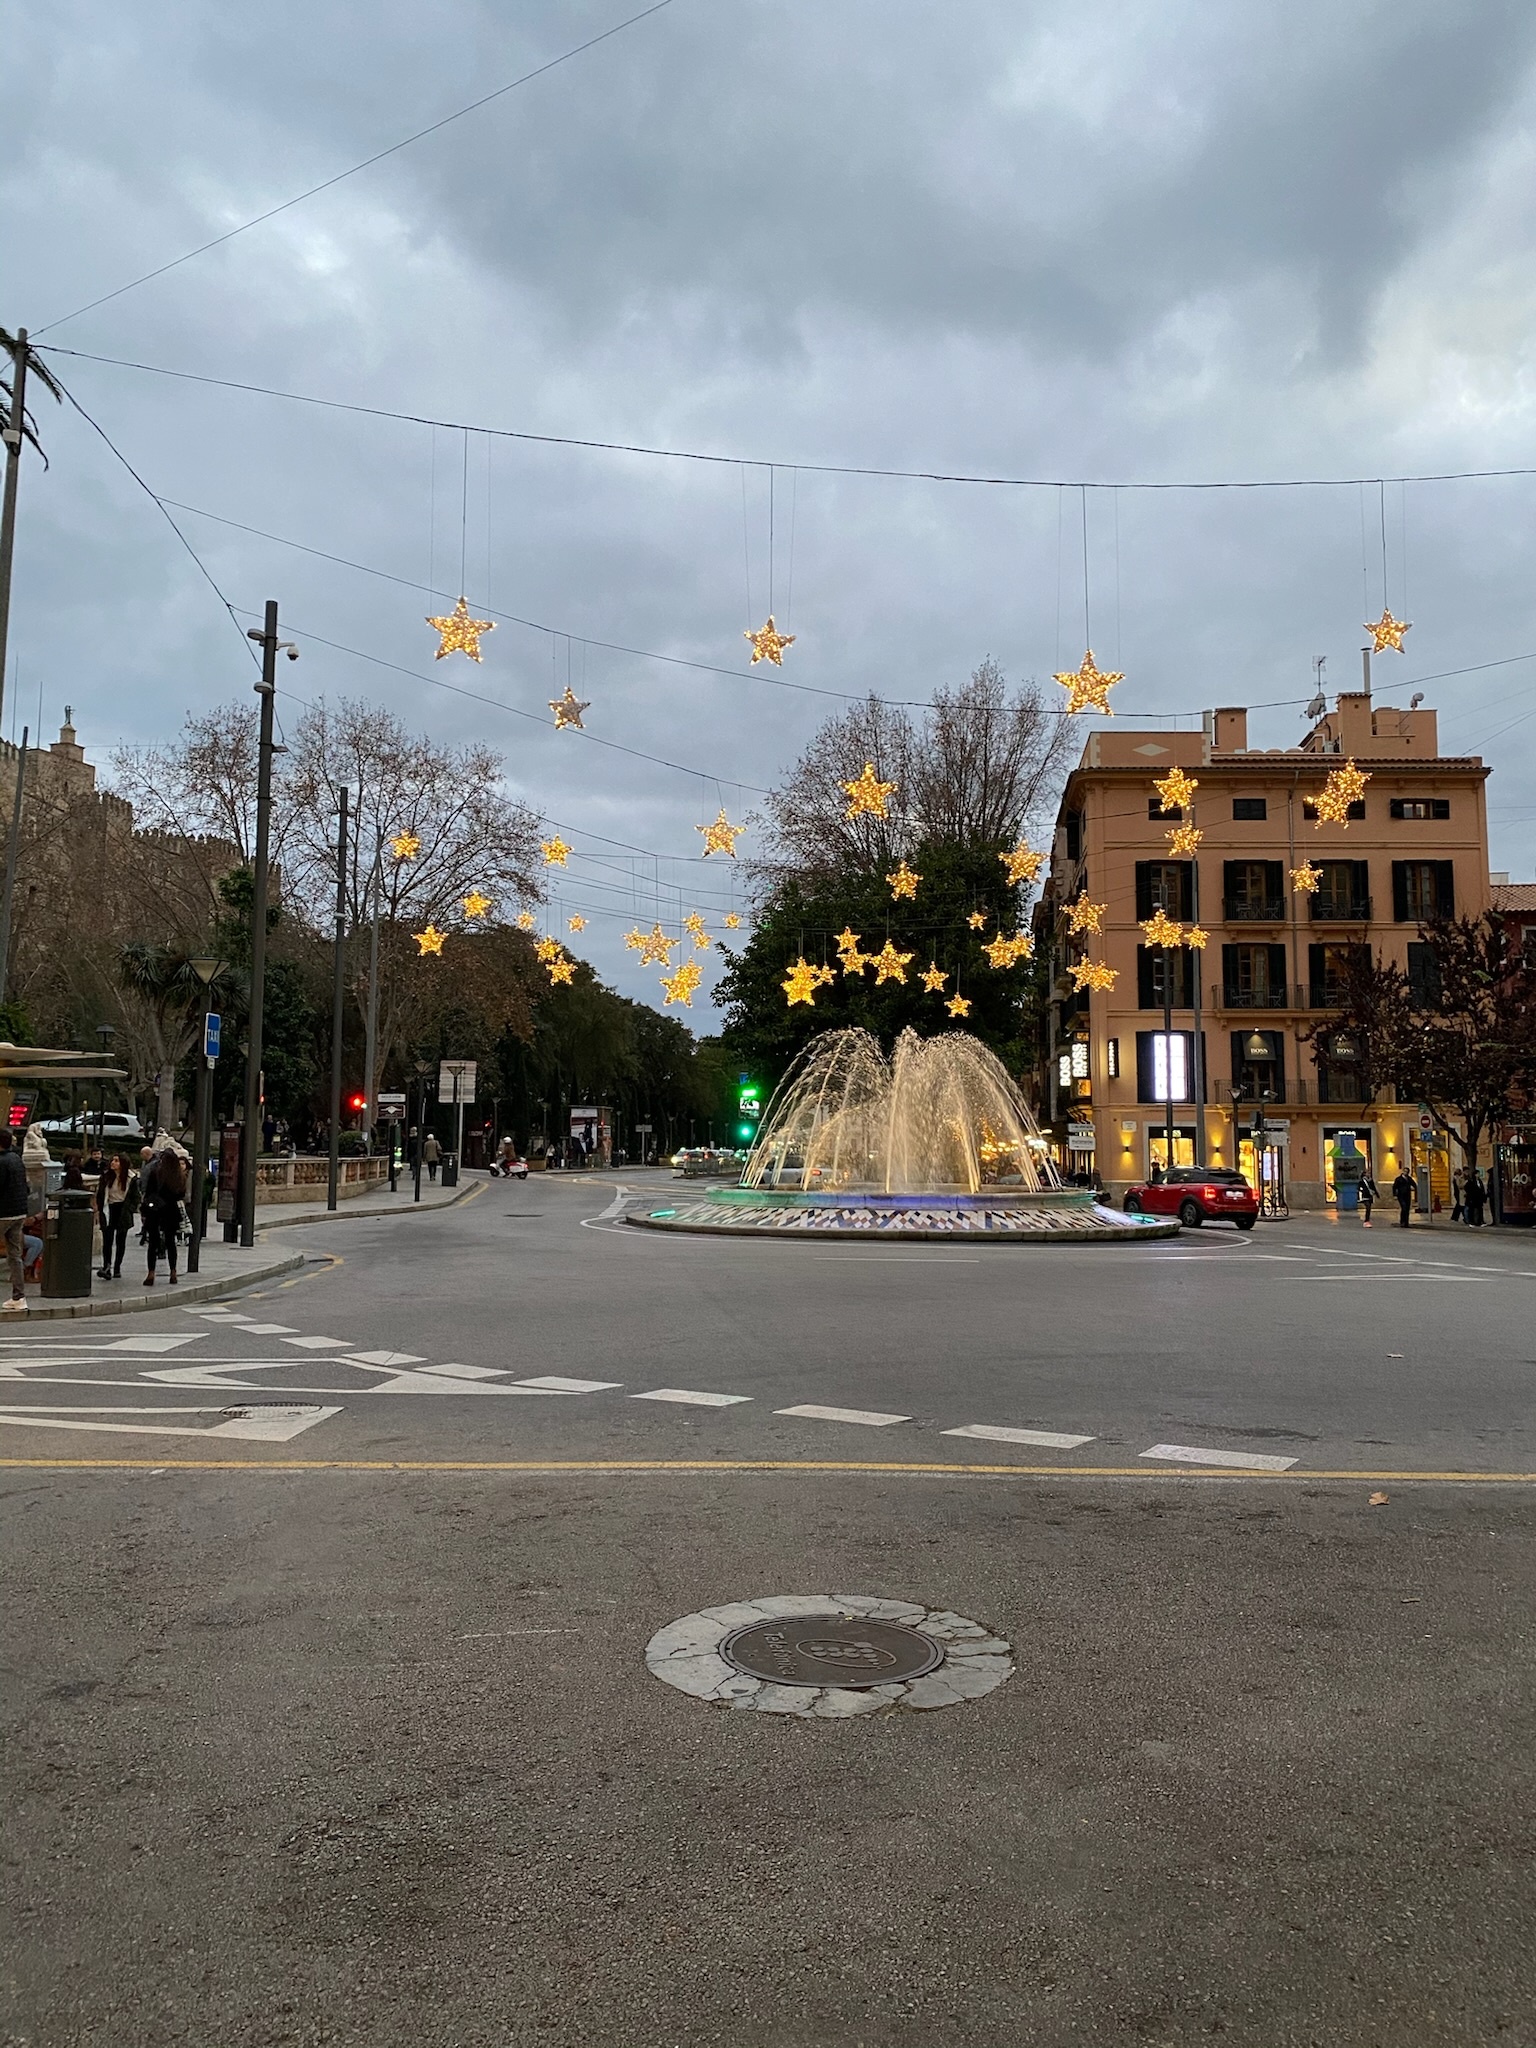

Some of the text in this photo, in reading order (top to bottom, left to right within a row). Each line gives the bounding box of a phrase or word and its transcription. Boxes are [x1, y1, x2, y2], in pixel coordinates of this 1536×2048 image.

[207, 1029, 219, 1042] TAXI
[1250, 1047, 1268, 1055] BOSS
[1059, 1055, 1071, 1086] BOSS
[1072, 1043, 1084, 1077] BOSS
[763, 1632, 797, 1676] Telefónica
